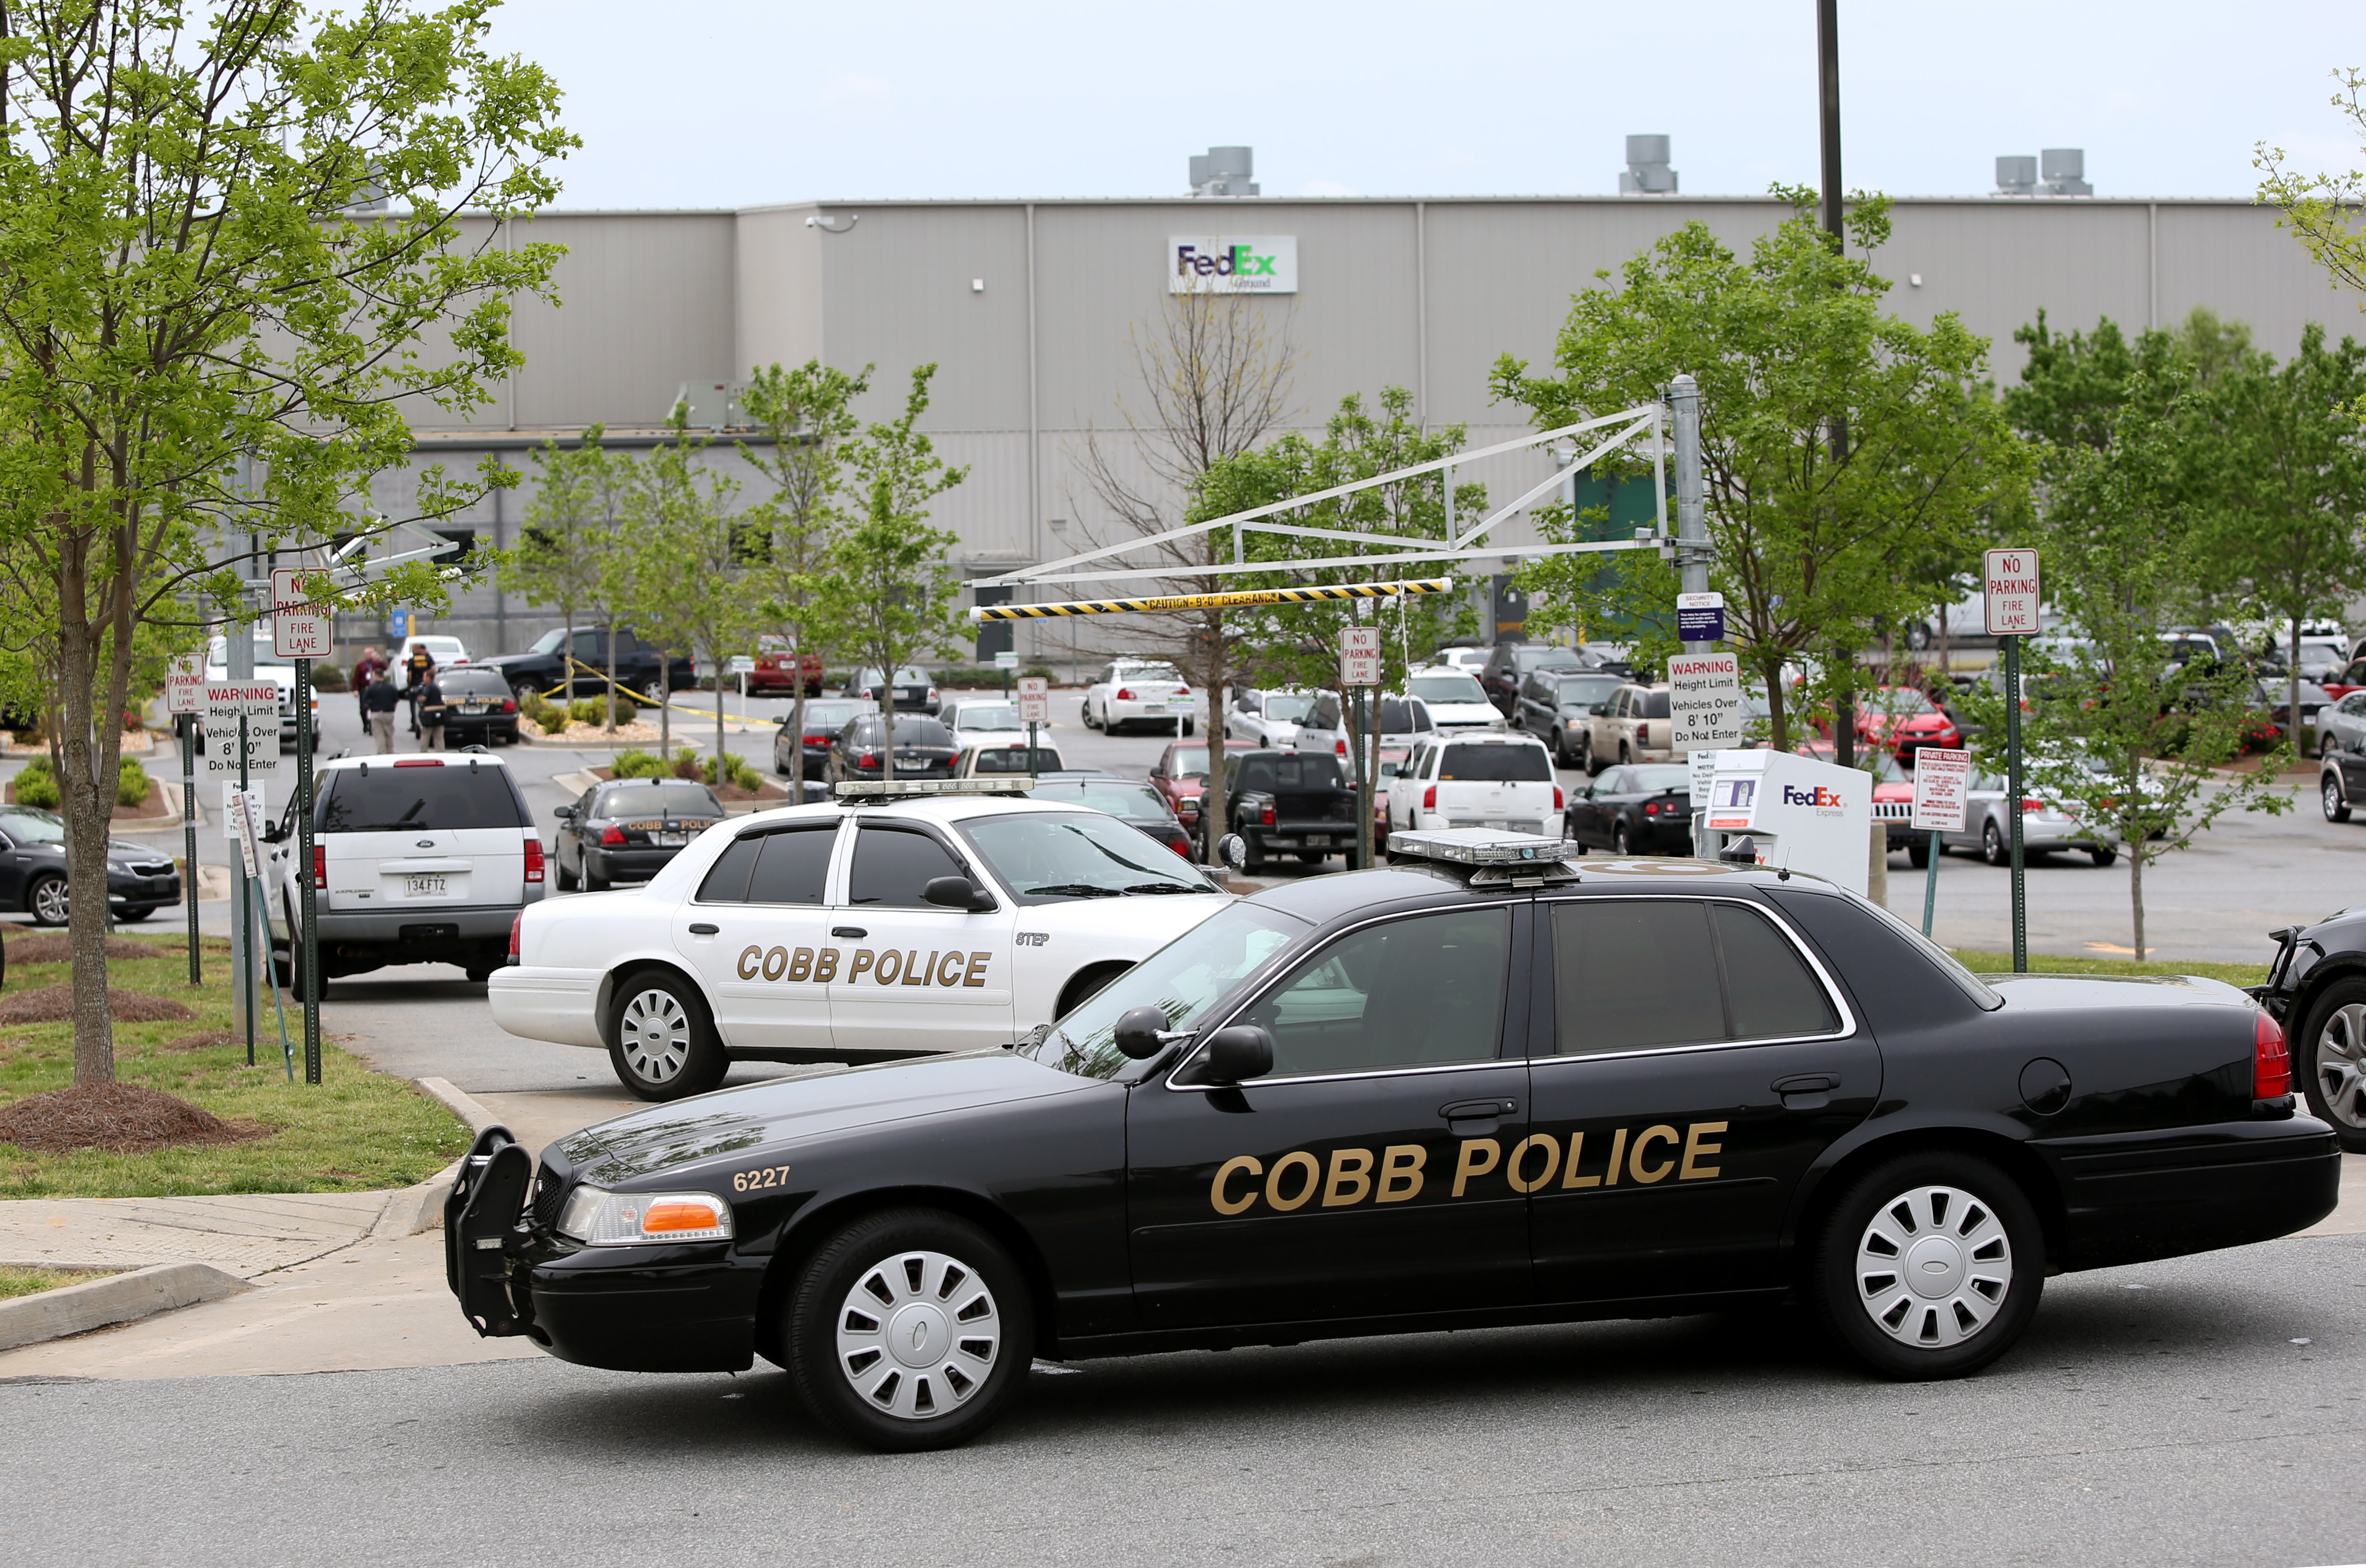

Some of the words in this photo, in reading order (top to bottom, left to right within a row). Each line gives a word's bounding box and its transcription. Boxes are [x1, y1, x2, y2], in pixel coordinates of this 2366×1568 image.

[1178, 245, 1276, 276] FedEx
[2003, 558, 2020, 573] NO
[1991, 579, 2035, 594] PARKING
[1222, 593, 1276, 605] CLEARANCE
[2003, 600, 2023, 611] FIRE
[2002, 615, 2026, 625] LANE
[291, 623, 314, 634] FIRE
[290, 638, 317, 649] LANE
[1353, 635, 1366, 644] NO
[1345, 649, 1375, 659] PARKING
[1672, 660, 1733, 675] WARNING
[169, 675, 202, 686] PARKING
[1675, 679, 1706, 691] Height
[1710, 678, 1733, 687] Limit
[1672, 700, 1712, 710] Vehicles
[1715, 698, 1738, 708] Over
[248, 705, 273, 715] Limit
[253, 726, 278, 736] Over
[1676, 732, 1689, 741] Do
[1692, 731, 1709, 740] Not
[1713, 729, 1738, 739] Enter
[1920, 751, 1942, 759] PRIVATE
[1943, 752, 1967, 761] PARKING
[209, 760, 223, 770] Do
[249, 759, 277, 769] Enter
[1784, 785, 1842, 807] FedEx
[1816, 808, 1843, 817] Express
[629, 821, 662, 830] COBB
[1016, 932, 1049, 946] STEP
[737, 945, 840, 983] COBB
[847, 949, 992, 987] POLICE
[1210, 1144, 1427, 1215] COBB
[1451, 1121, 1728, 1197] POLICE
[733, 1165, 790, 1192] 6227
